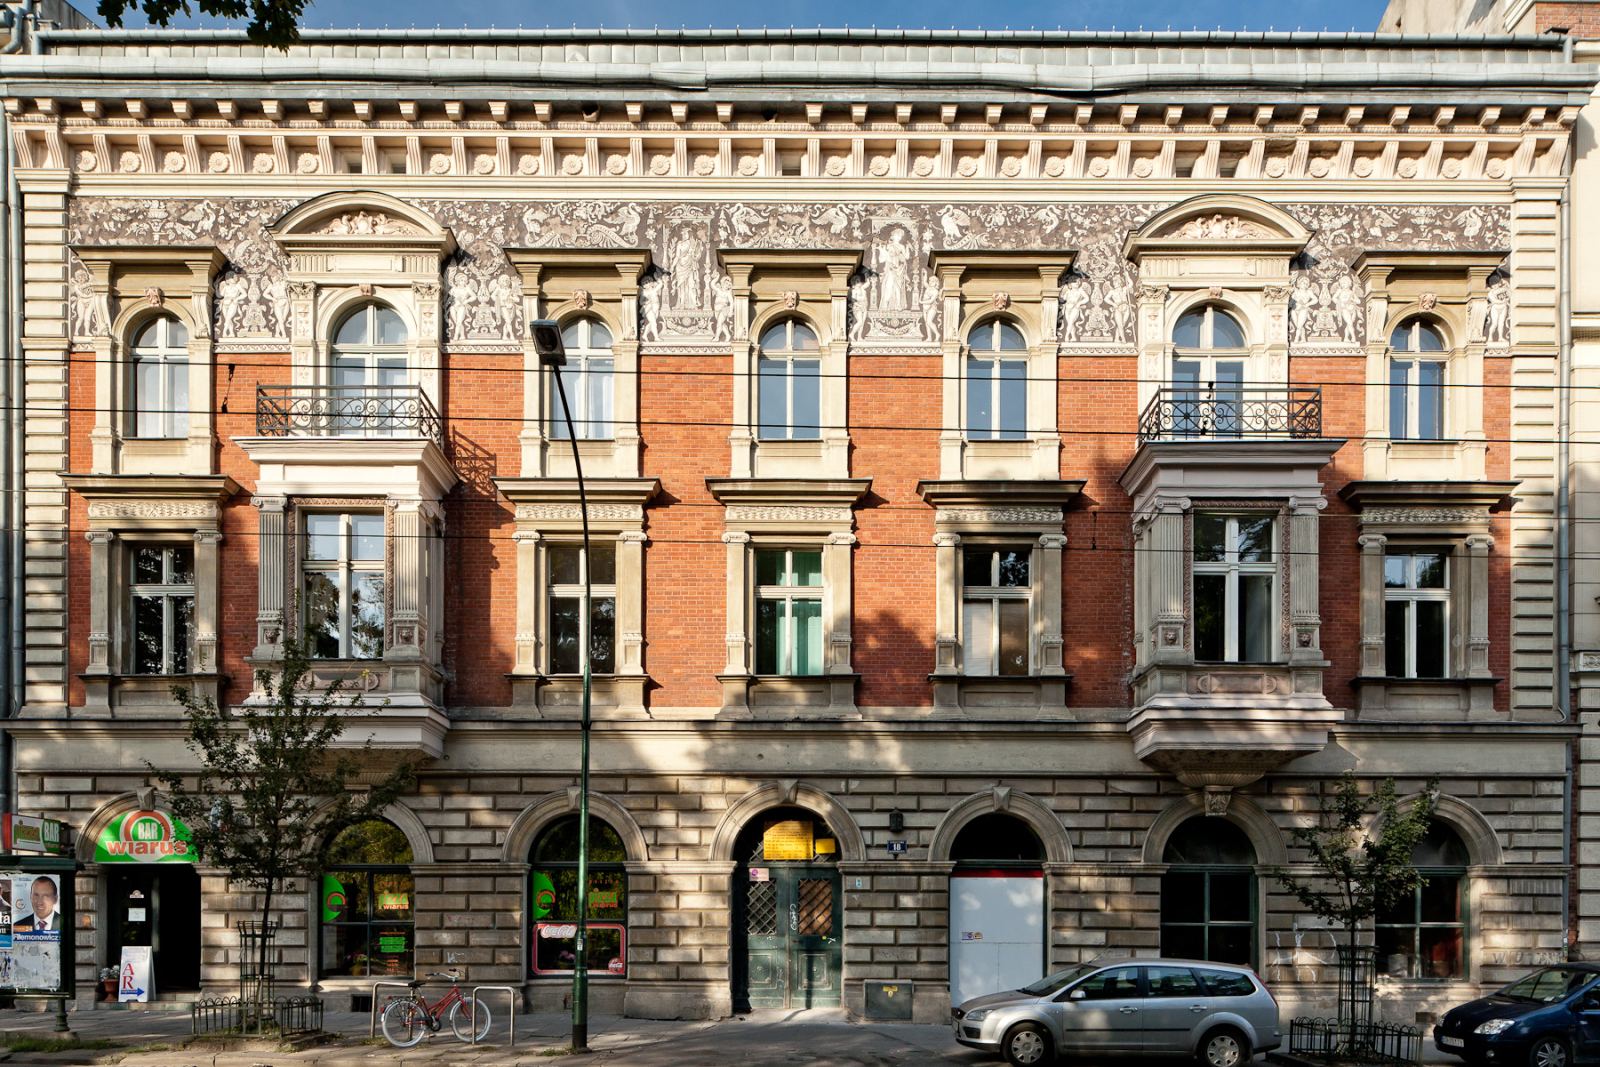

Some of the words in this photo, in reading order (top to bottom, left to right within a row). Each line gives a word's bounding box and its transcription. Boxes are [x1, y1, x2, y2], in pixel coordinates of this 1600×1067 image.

[44, 821, 60, 842] BAR
[138, 822, 158, 840] BAR
[106, 841, 188, 855] wiarus
